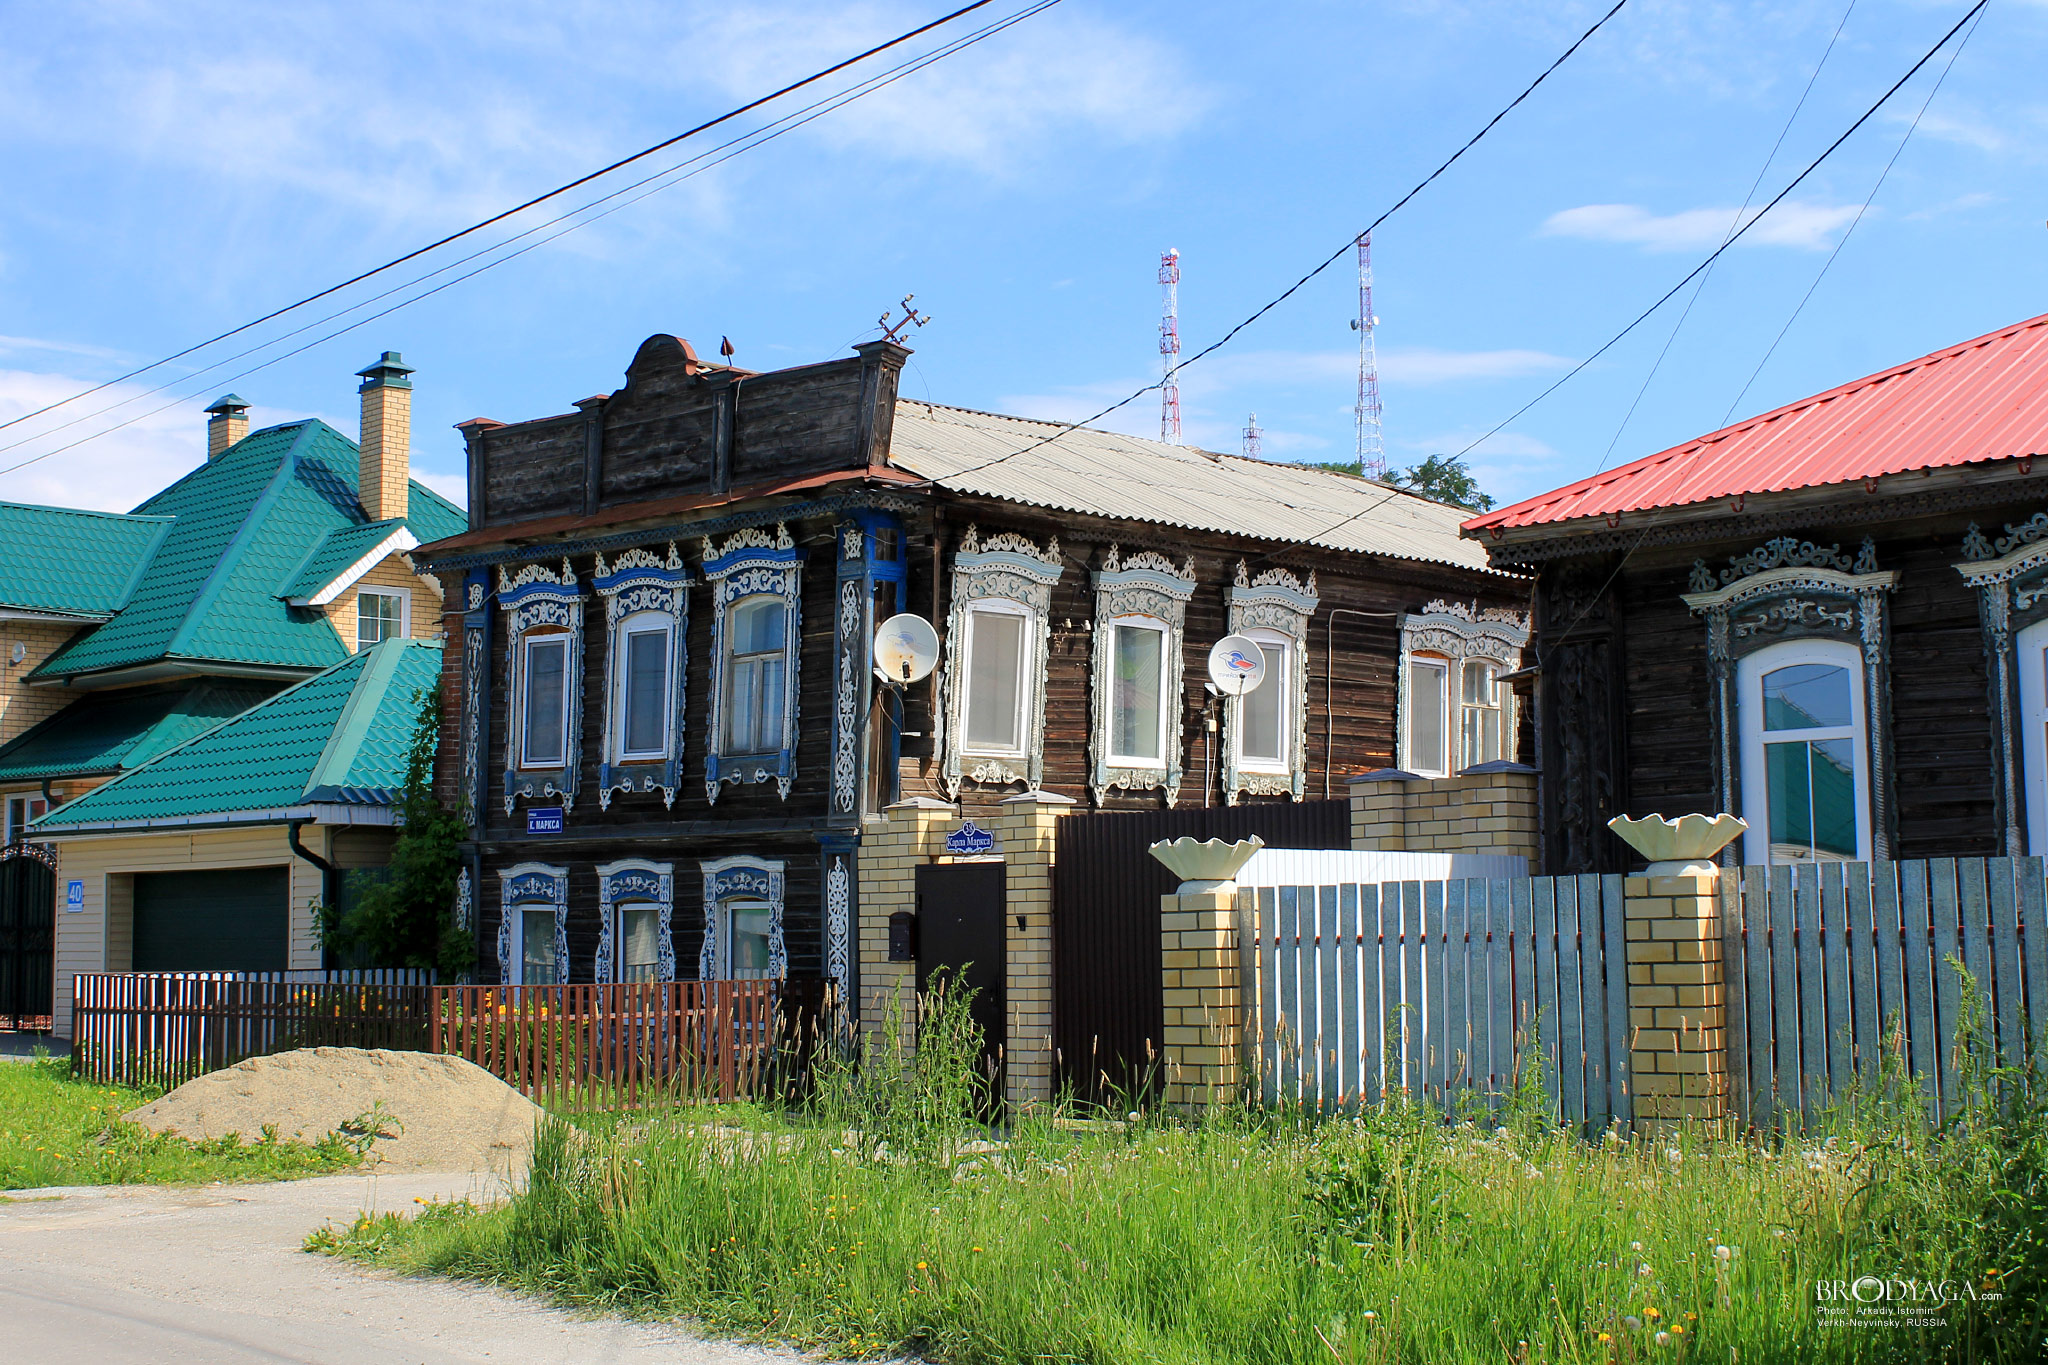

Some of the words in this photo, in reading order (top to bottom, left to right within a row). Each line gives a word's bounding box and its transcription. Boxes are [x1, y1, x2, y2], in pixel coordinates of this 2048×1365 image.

[536, 820, 560, 830] МАРКСА
[947, 837, 966, 849] Карла
[967, 836, 990, 848] Маркса
[69, 884, 82, 902] 40
